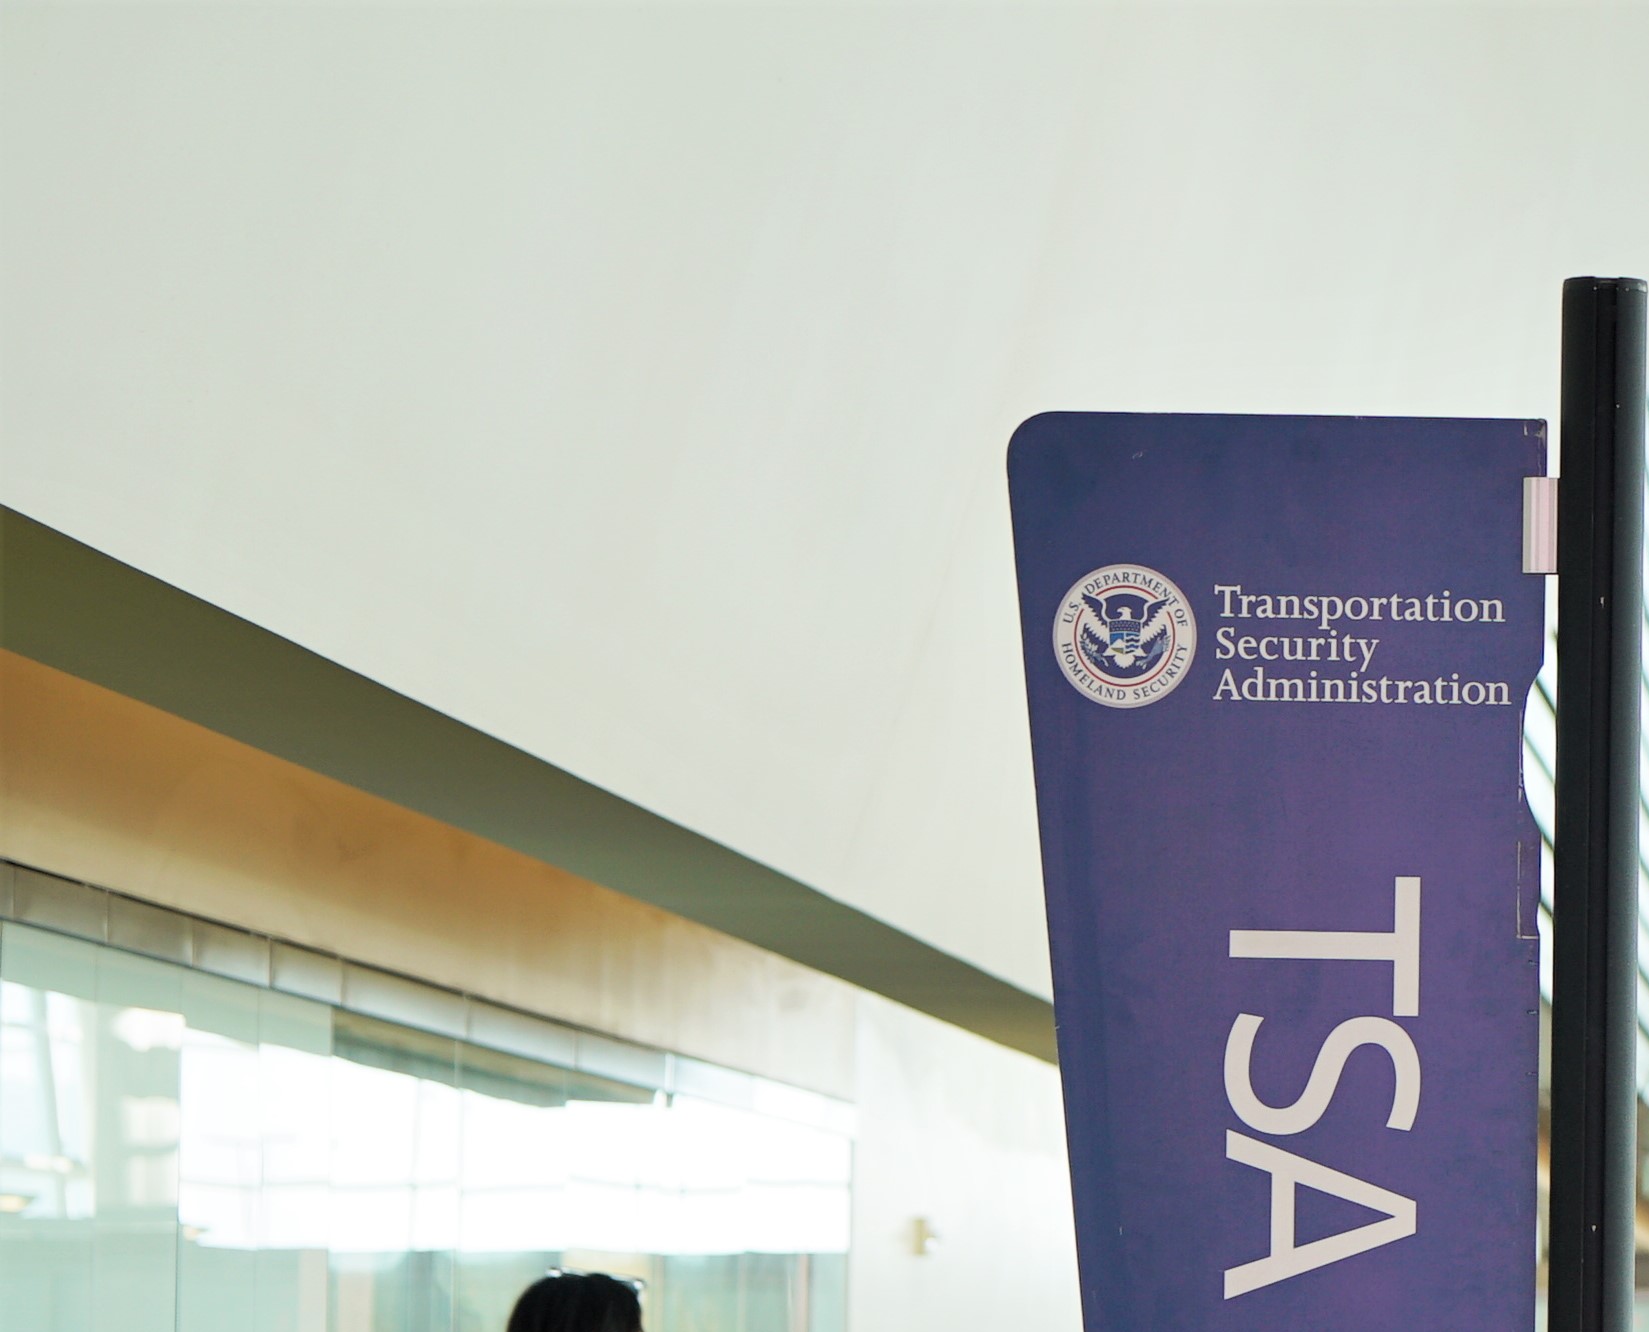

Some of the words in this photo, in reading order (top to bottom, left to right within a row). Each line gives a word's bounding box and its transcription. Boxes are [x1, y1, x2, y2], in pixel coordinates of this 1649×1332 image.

[1063, 601, 1082, 624] U.S.
[1084, 572, 1179, 606] DEPARTMENT
[1174, 609, 1188, 627] OF
[1213, 584, 1506, 629] Transportation
[1061, 643, 1126, 700] HOMELAND
[1133, 643, 1188, 700] SECURITY
[1215, 627, 1380, 672] Security
[1212, 666, 1512, 706] Administration
[1223, 876, 1422, 1300] TSA
